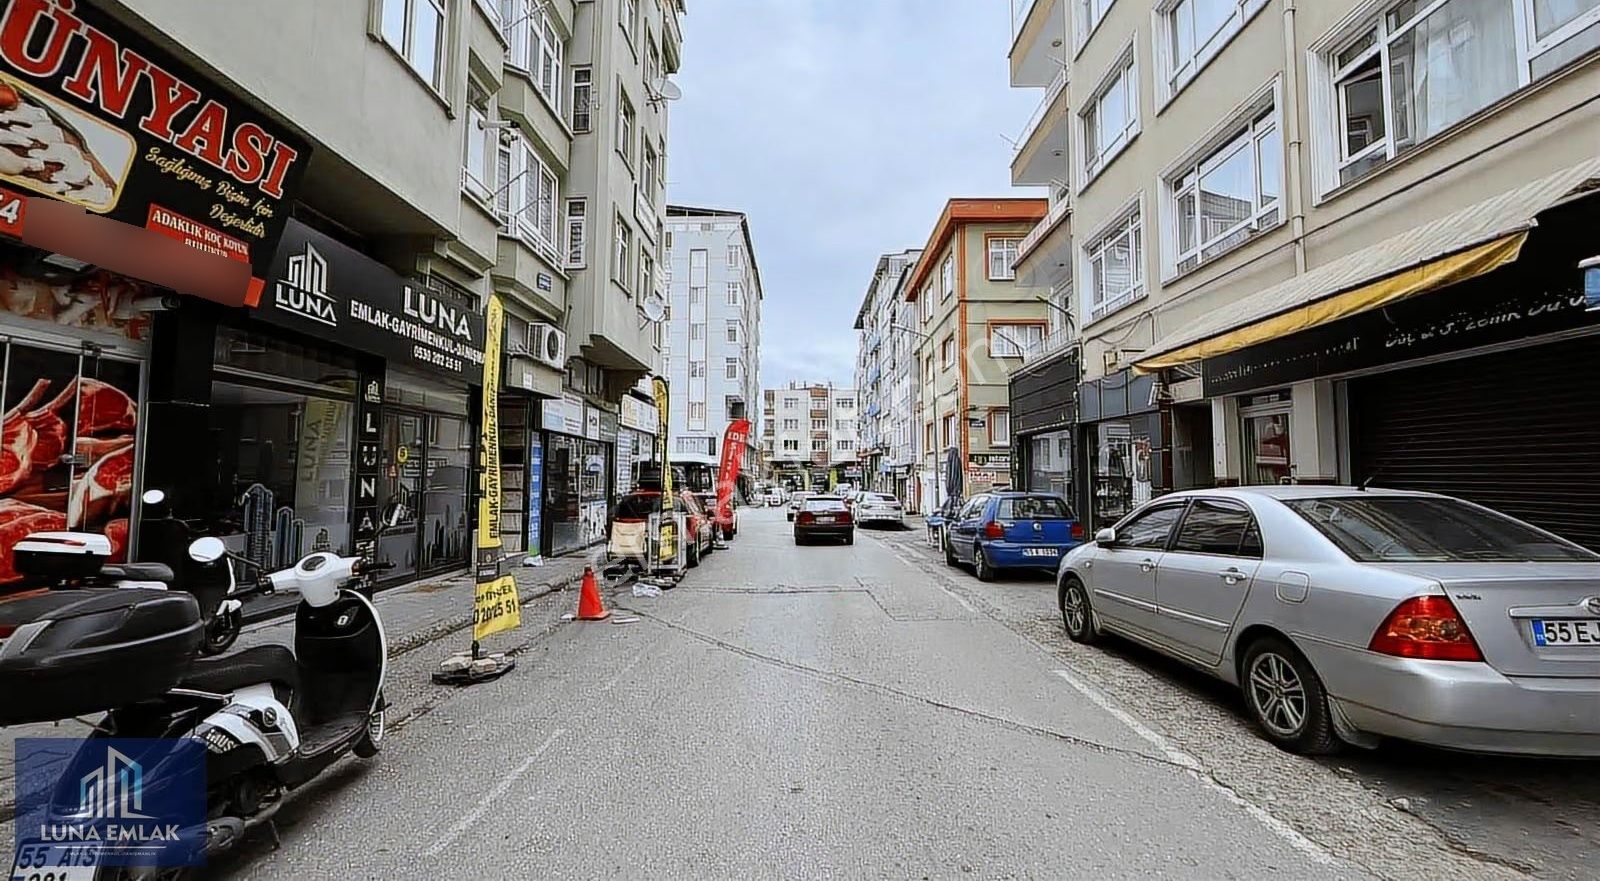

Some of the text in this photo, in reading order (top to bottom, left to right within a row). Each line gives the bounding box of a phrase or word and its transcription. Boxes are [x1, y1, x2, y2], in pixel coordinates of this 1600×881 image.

[152, 210, 202, 238] ADAKLIK
[204, 229, 222, 249] KOÇ
[275, 283, 337, 322] LUNA
[403, 285, 472, 341] LUNA
[1544, 622, 1571, 643] 55
[19, 846, 50, 869] 55
